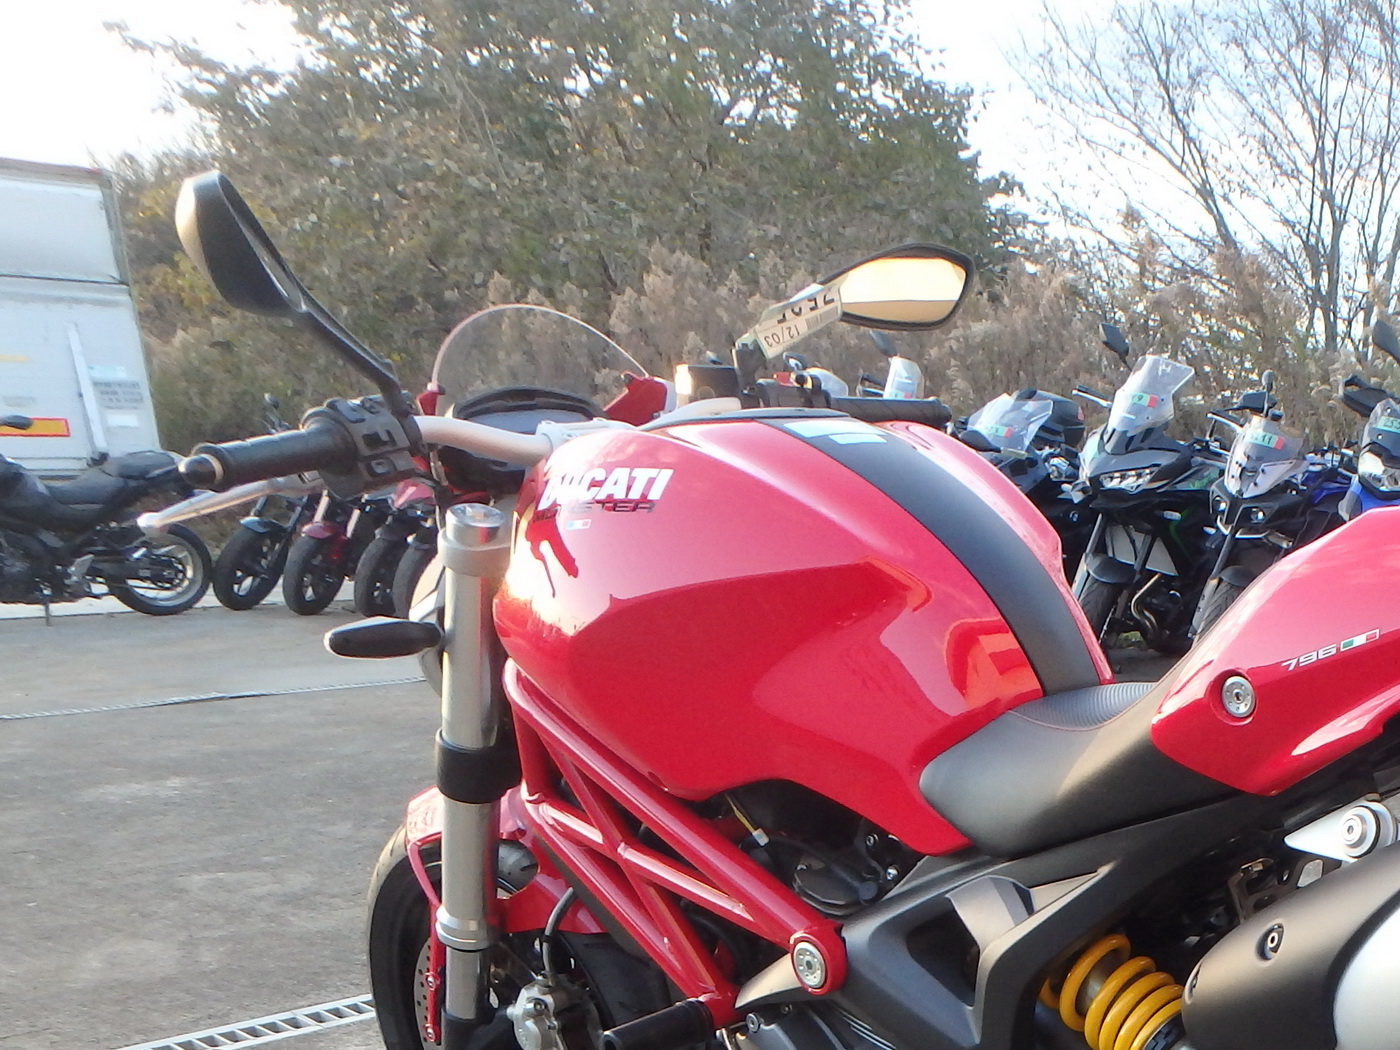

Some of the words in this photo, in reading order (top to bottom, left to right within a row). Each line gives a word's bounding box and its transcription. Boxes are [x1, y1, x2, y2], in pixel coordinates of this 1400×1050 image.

[764, 323, 801, 348] 12/03
[538, 467, 675, 511] DUCATI
[1281, 643, 1337, 671] 796
